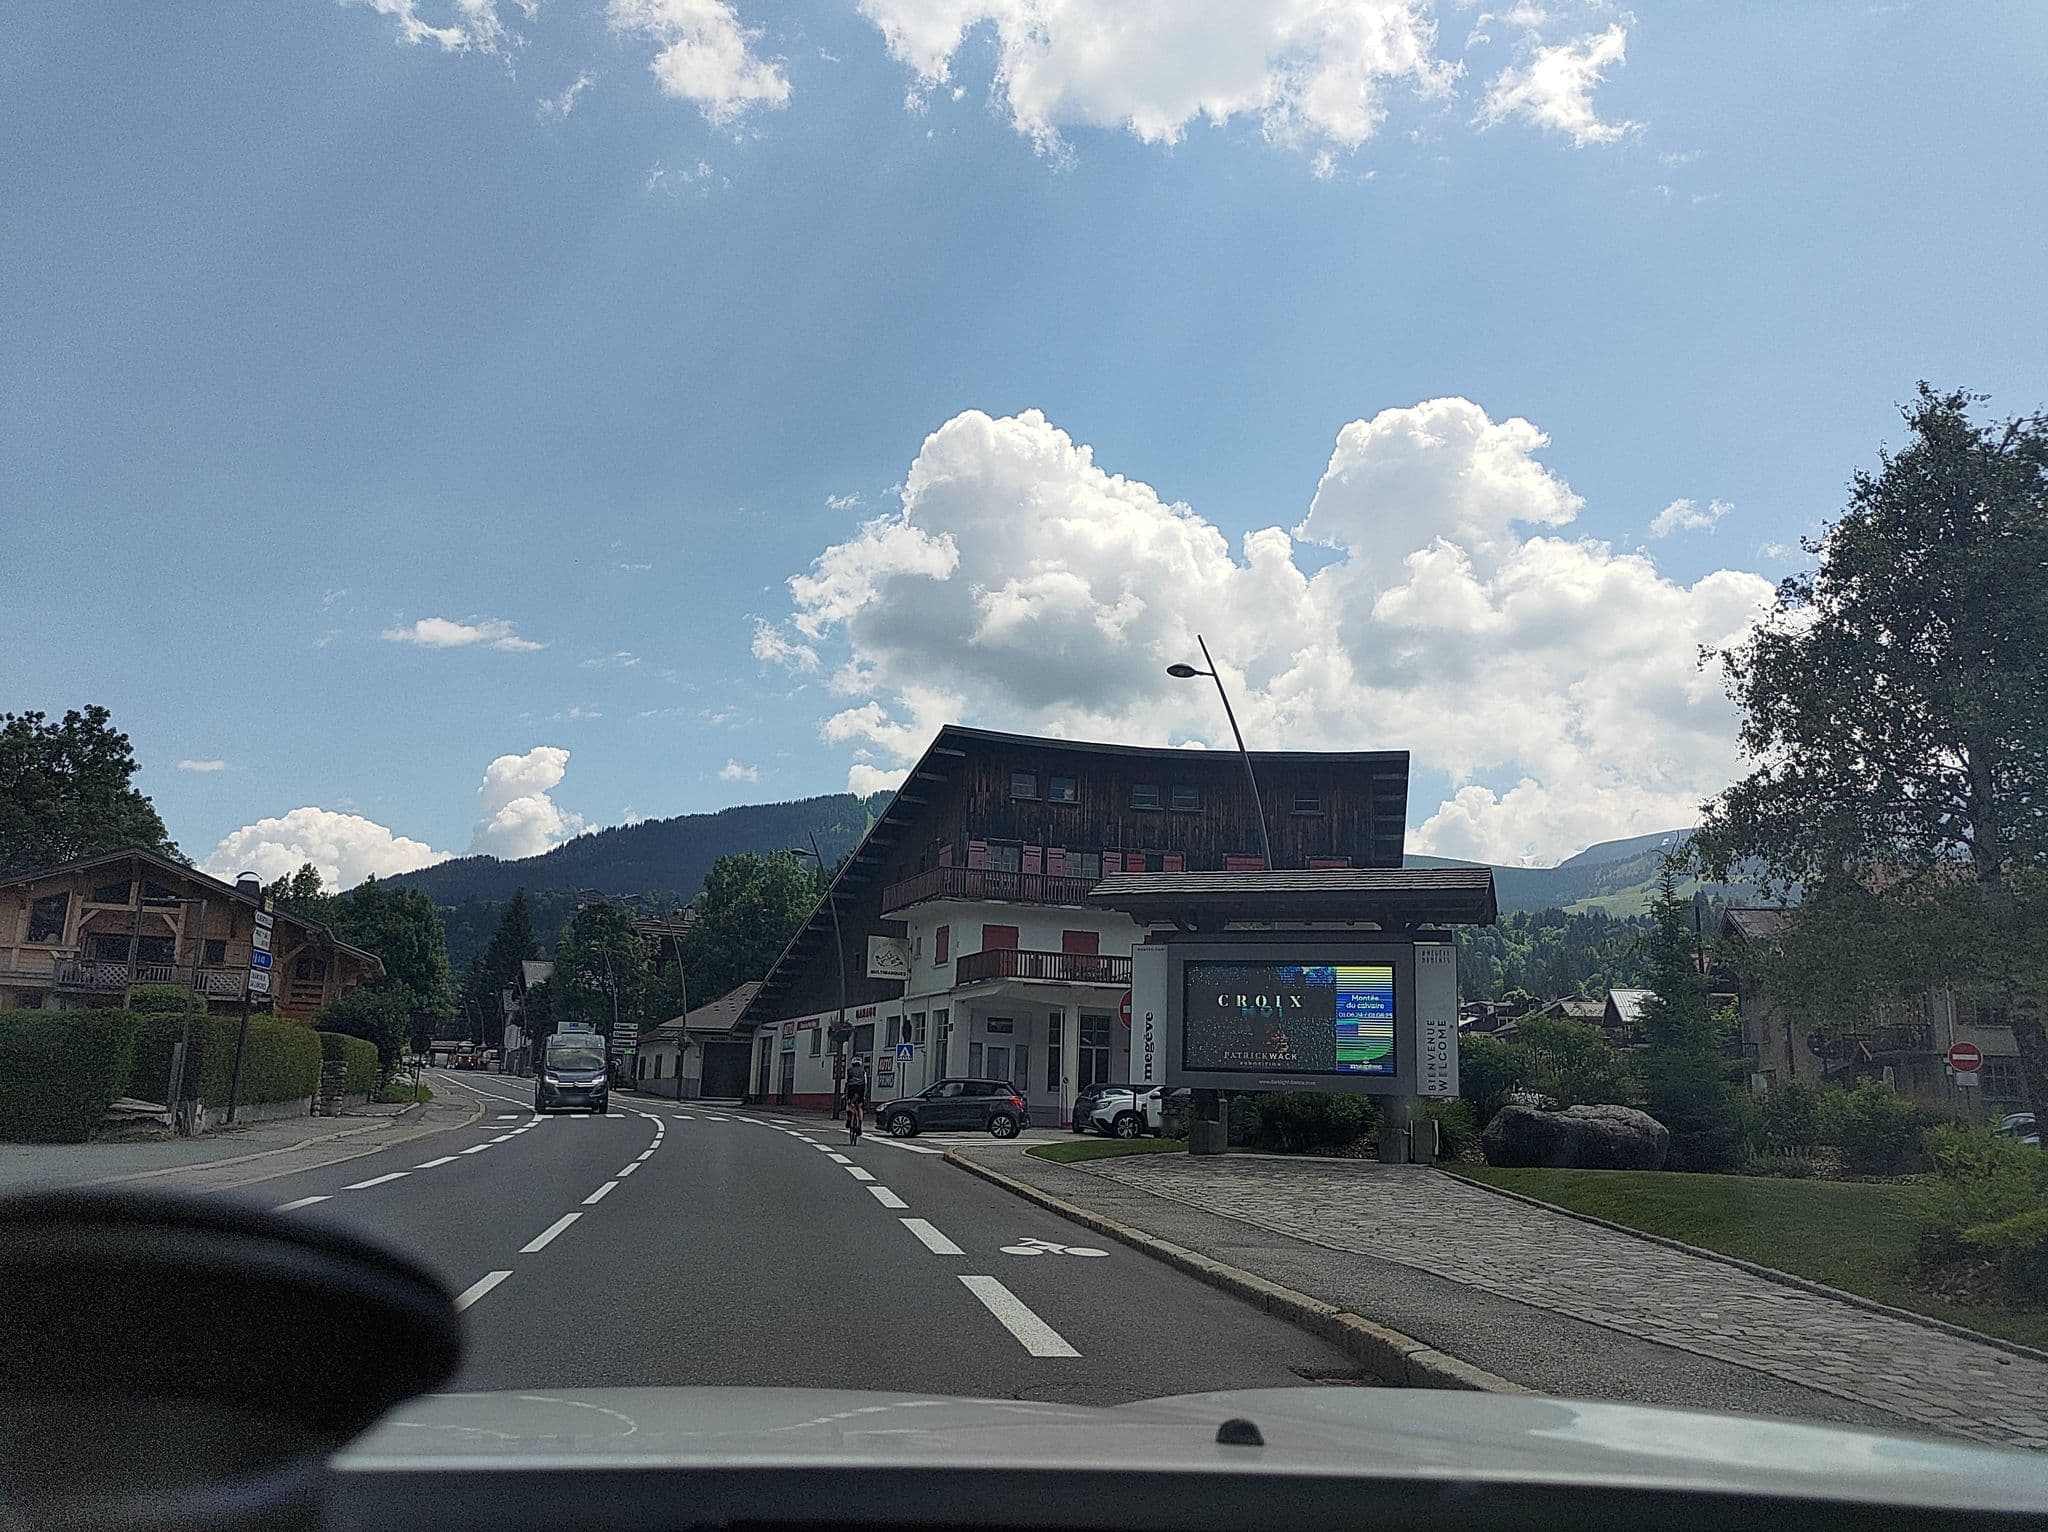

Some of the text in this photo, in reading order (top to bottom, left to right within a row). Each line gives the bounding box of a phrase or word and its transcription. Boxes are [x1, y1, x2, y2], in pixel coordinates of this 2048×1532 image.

[1217, 994, 1302, 1008] CROIX
[1426, 1020, 1437, 1091] BIENVENUE
[1437, 1020, 1448, 1091] WELCOME
